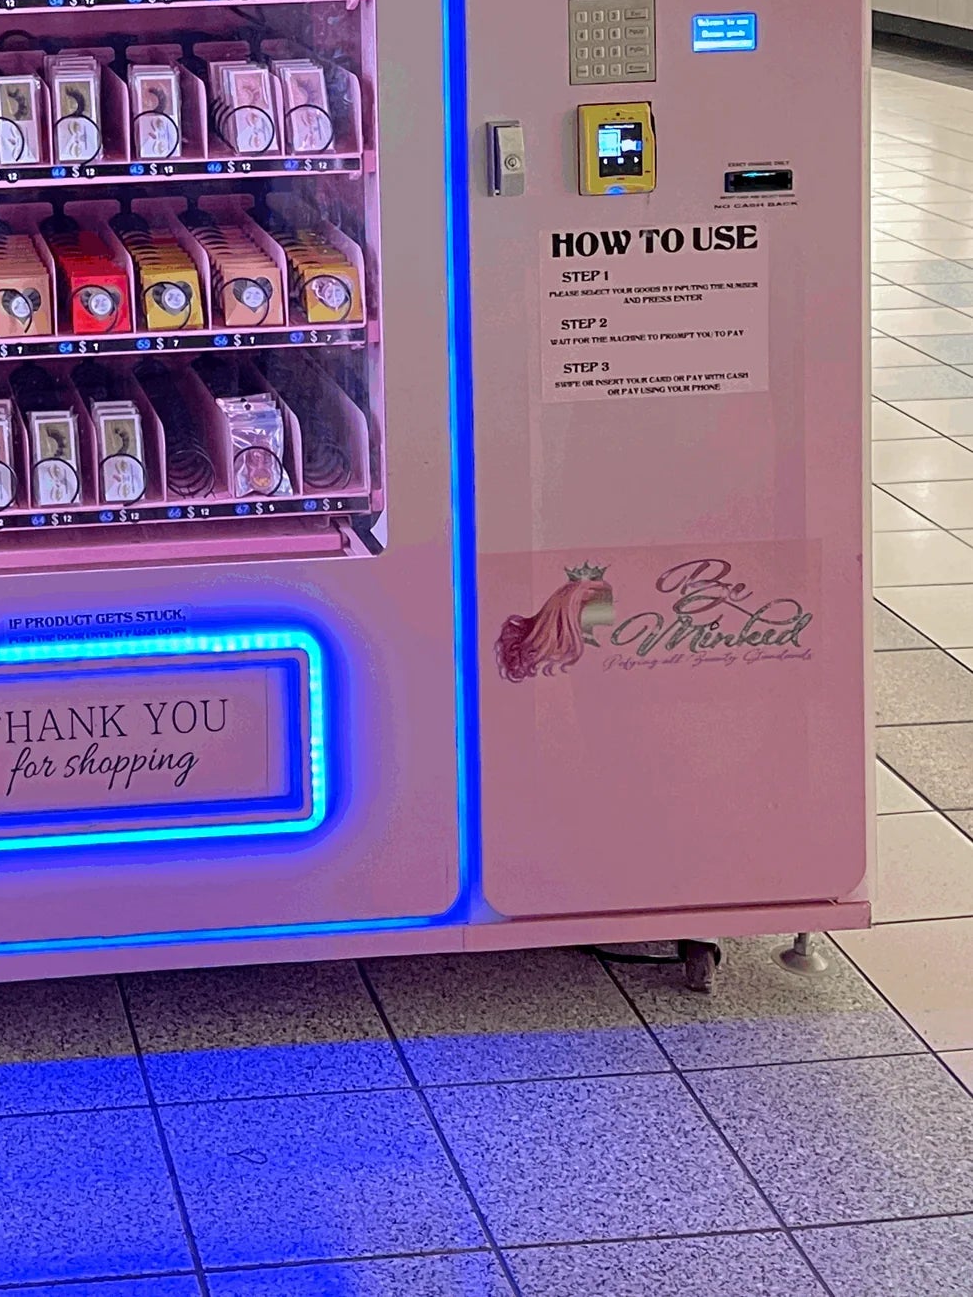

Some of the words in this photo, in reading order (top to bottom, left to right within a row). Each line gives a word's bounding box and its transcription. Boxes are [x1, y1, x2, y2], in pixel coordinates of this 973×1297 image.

[149, 163, 157, 176] $
[164, 166, 174, 174] 12
[552, 229, 631, 258] HOW
[639, 228, 684, 254] TO
[692, 225, 758, 251] USE
[562, 270, 600, 283] STEP
[603, 270, 609, 281] 1
[549, 290, 579, 298] PLEASE
[581, 288, 610, 296] SELECT
[612, 287, 633, 295] YOUR
[634, 286, 660, 294] GOODS
[662, 285, 673, 293] BY
[726, 282, 758, 290] NUMBER
[623, 296, 641, 304] AND
[642, 295, 672, 304] PRESS
[673, 294, 703, 302] ENTER
[561, 319, 597, 330] STEP
[599, 318, 608, 328] 2
[550, 338, 571, 346] WAIT
[573, 337, 590, 345] FOR
[591, 336, 608, 344] THE
[610, 335, 646, 343] MACHINE
[647, 333, 659, 341] TO
[660, 332, 694, 340] PROMPT
[696, 331, 713, 339] YOU
[714, 330, 725, 338] TO
[727, 329, 744, 337] PAY
[563, 362, 598, 374] STEP
[601, 362, 610, 372] 3
[555, 381, 580, 389] SWIPE
[595, 378, 625, 386] INSERT
[626, 377, 648, 385] YOUR
[649, 375, 672, 383] CARD
[673, 374, 685, 382] OR
[727, 372, 749, 380] CASH
[607, 388, 621, 396] OR
[621, 387, 640, 395] PAY
[640, 386, 666, 394] USING
[667, 385, 690, 393] YOUR
[691, 383, 721, 392] PHONE
[9, 618, 22, 630] IF
[25, 614, 92, 629] PRODUCT
[95, 611, 133, 625] GETS
[136, 609, 186, 623] STUCK,
[143, 699, 229, 735] YOU
[5, 747, 56, 797] for
[63, 742, 200, 790] shopping
